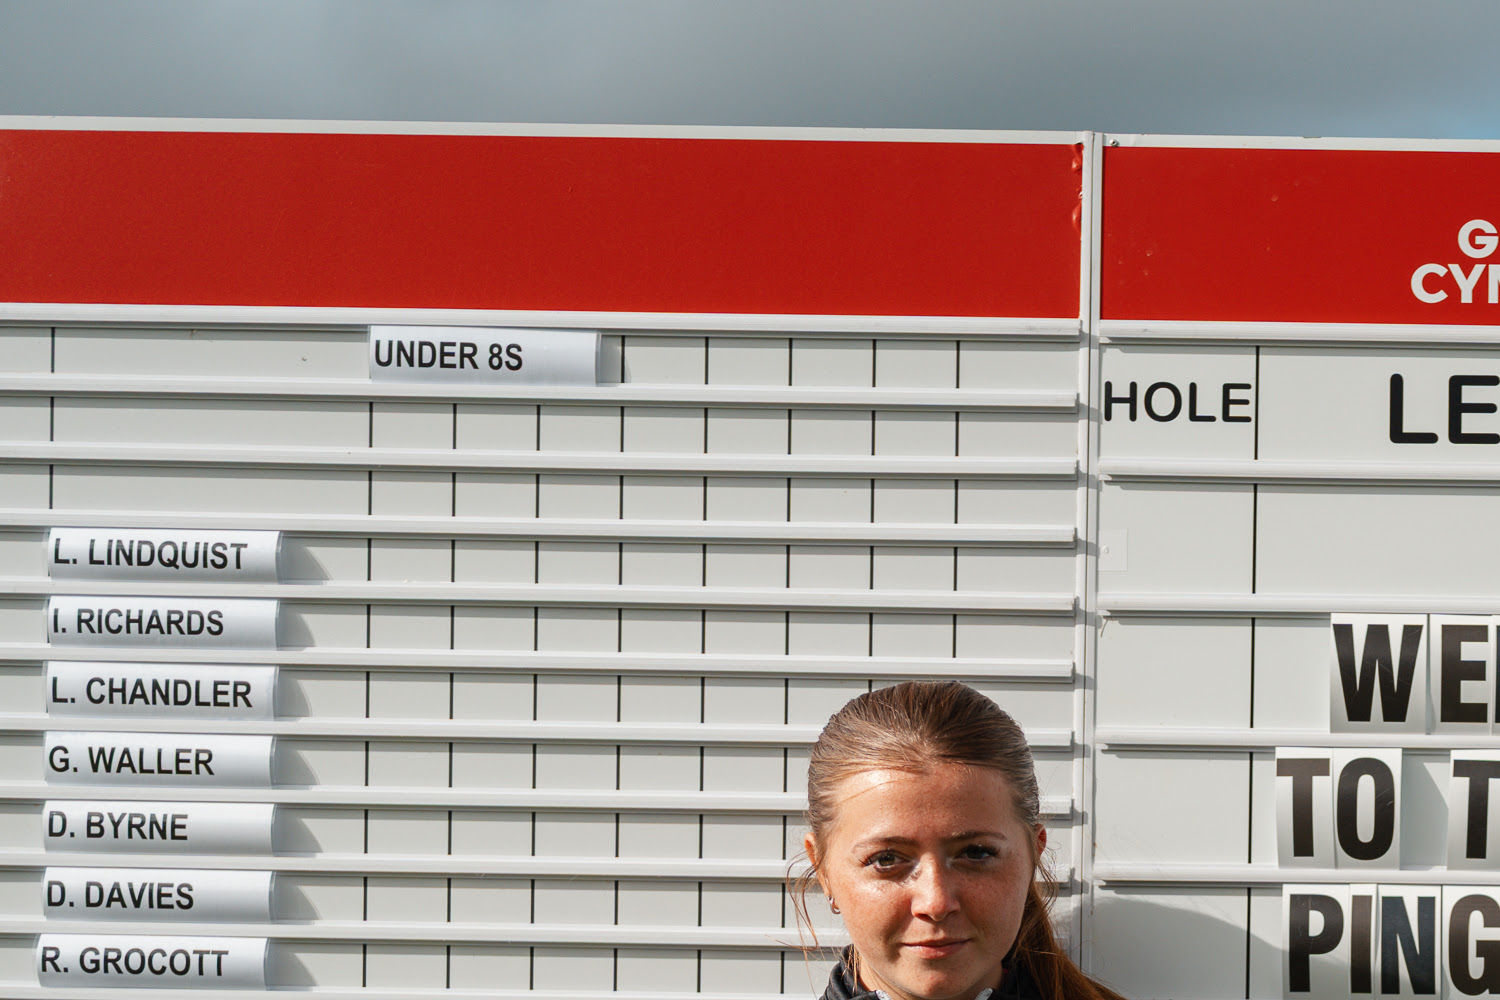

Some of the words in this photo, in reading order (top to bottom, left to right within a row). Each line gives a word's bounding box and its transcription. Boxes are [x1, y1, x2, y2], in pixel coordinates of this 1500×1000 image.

[374, 339, 480, 370] UNDER
[488, 343, 523, 372] 8S
[1104, 380, 1252, 423] HOLE
[54, 538, 78, 565] L.
[88, 539, 248, 571] LINDQUIST
[53, 608, 67, 634] I.
[76, 609, 224, 637] RICHARDS
[51, 676, 76, 704] L.
[86, 677, 253, 708] CHANDLER
[48, 745, 78, 773] G.
[88, 746, 215, 776] WALLER
[1276, 757, 1395, 861] TO
[48, 812, 75, 838] D.
[86, 812, 188, 841] BYRNE
[47, 881, 75, 908] D.
[85, 881, 194, 911] DAVIES
[41, 946, 69, 973] R.
[79, 947, 229, 977] GROCOTT
